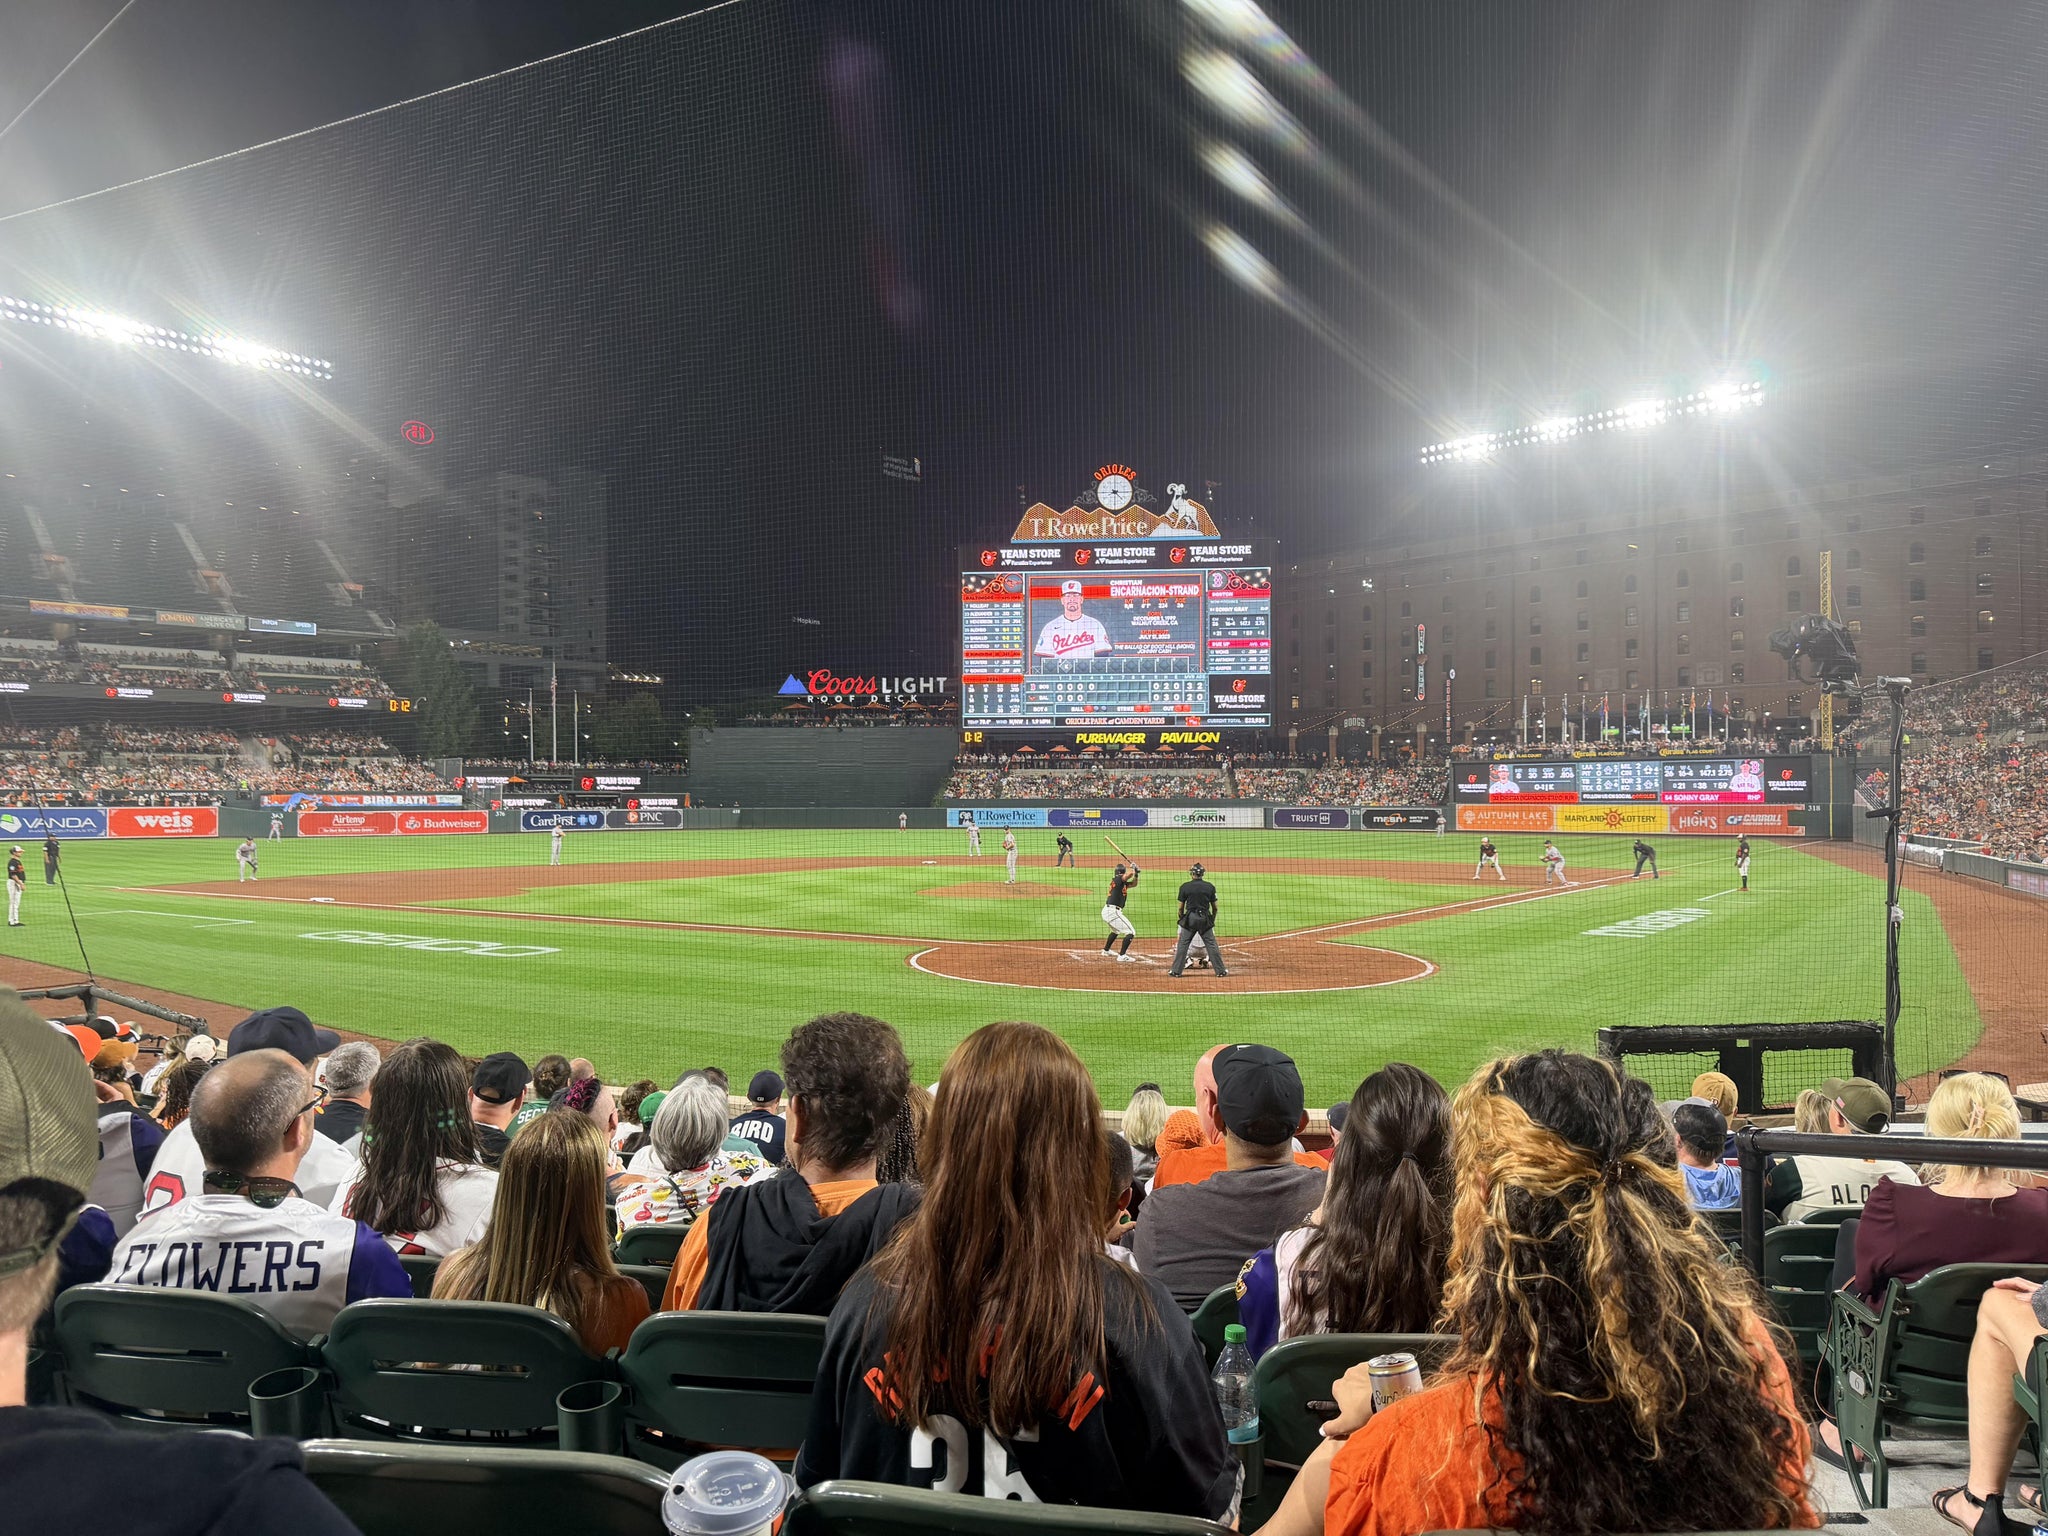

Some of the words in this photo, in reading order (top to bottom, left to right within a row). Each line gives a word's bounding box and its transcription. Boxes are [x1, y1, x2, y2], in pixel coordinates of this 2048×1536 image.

[1094, 464, 1137, 481] ORIOLES
[1049, 518, 1100, 538] Rowe
[1100, 516, 1148, 536] Price
[1000, 549, 1028, 558] TEAM
[1029, 548, 1060, 558] STORE
[1094, 548, 1122, 557] TEAM
[1124, 547, 1155, 556] STORE
[1190, 546, 1220, 555] TEAM
[1221, 546, 1251, 554] STORE
[1110, 585, 1199, 596] ENCARNACION-STRAND
[808, 669, 877, 694] Coors
[882, 677, 948, 693] LIGHT
[390, 700, 410, 712] 0:12
[964, 732, 982, 742] 0:12
[1076, 732, 1146, 744] PUREWAGER
[1160, 732, 1220, 743] PAVILION
[363, 796, 393, 805] BIRD
[397, 796, 427, 805] BATH
[134, 811, 193, 828] weis
[333, 815, 365, 825] Airtemp
[531, 815, 576, 826] CareFirst
[640, 812, 662, 821] PNC
[984, 811, 1011, 820] Rowe
[1012, 810, 1035, 820] Price
[1291, 814, 1318, 823] TRUIST
[1477, 811, 1519, 819] AUTUMN
[1523, 811, 1548, 819] LAKE
[1744, 814, 1782, 822] CARROLL
[23, 817, 97, 828] VANDA
[1680, 816, 1717, 829] HIGH'S
[117, 1240, 324, 1293] FLOWERS
[1855, 1377, 1860, 1390] 6
